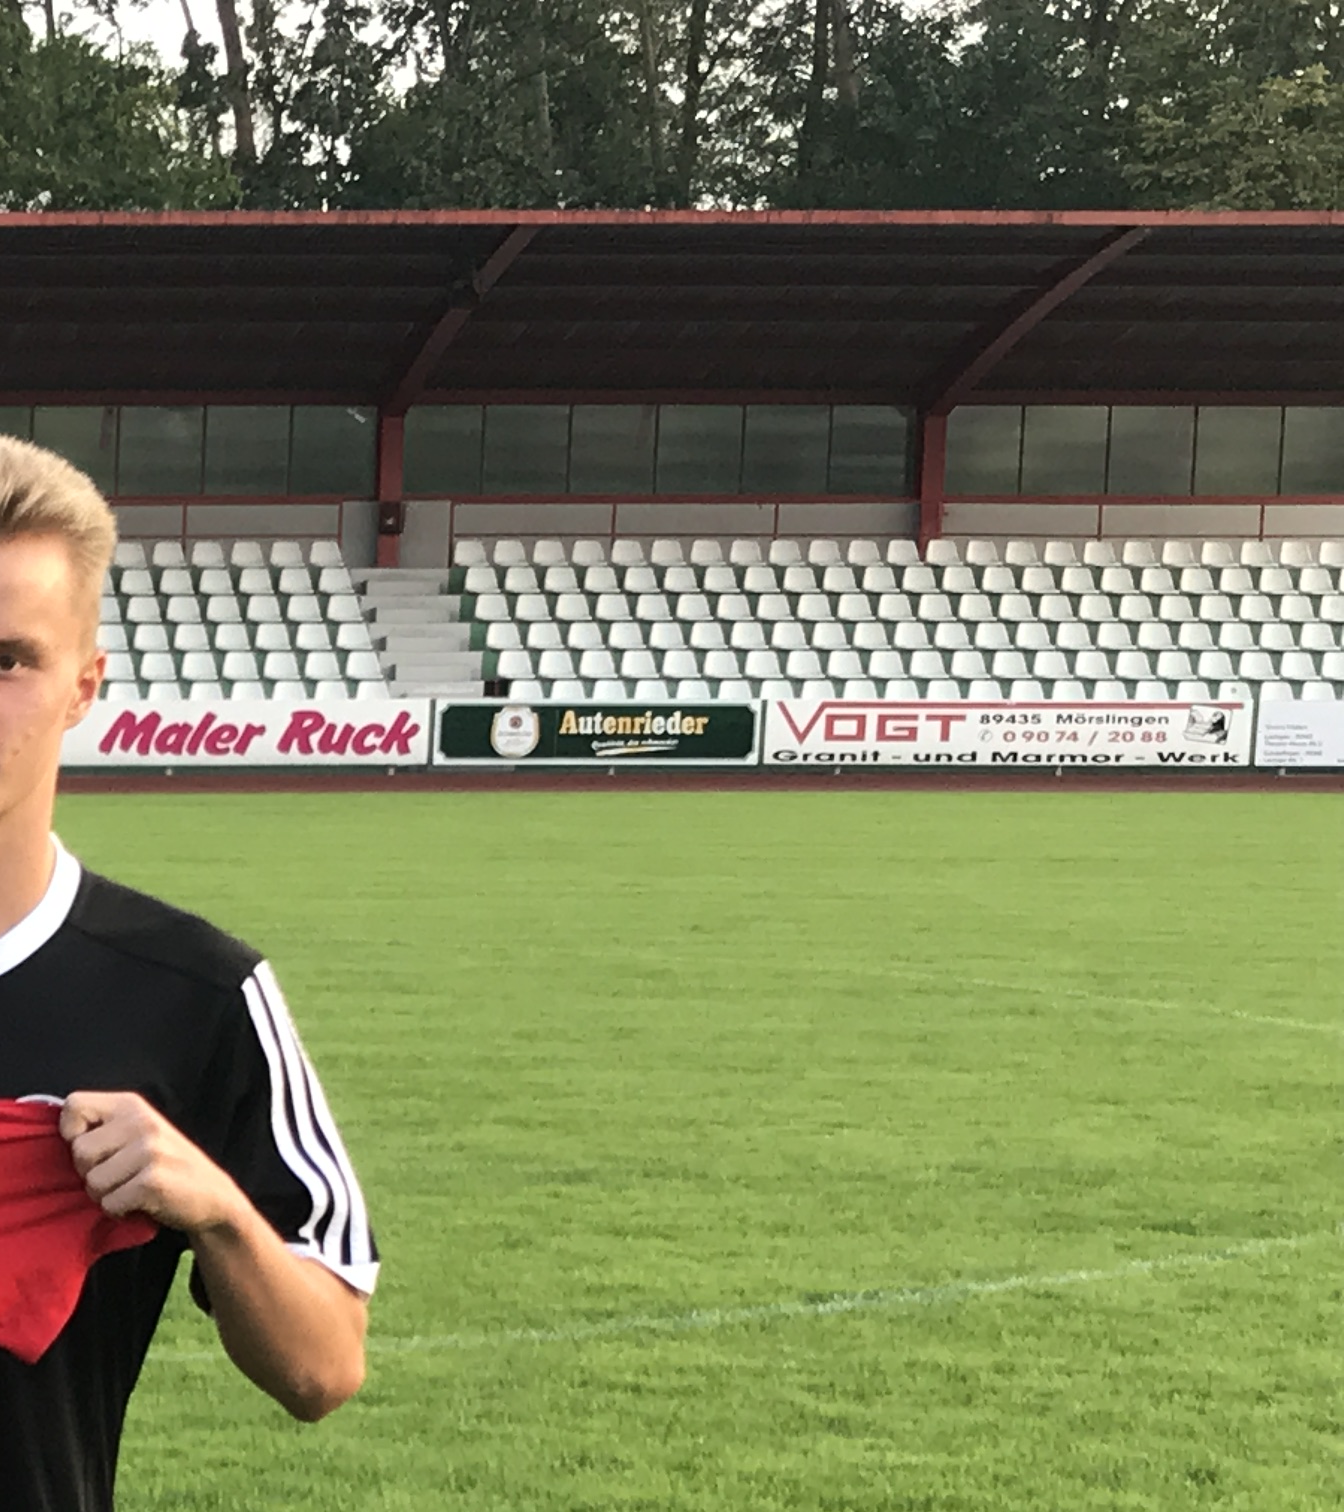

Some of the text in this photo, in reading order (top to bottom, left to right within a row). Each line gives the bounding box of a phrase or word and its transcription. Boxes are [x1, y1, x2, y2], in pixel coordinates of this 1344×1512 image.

[98, 709, 421, 756] Maler Ruck
[559, 709, 710, 735] Autenrieder
[777, 701, 967, 745] VOGT
[979, 712, 1170, 727] 89435 Mörslingen
[773, 750, 880, 763] Granit
[913, 751, 977, 763] und
[991, 751, 1125, 764] Marmor
[1157, 751, 1240, 763] Werk
